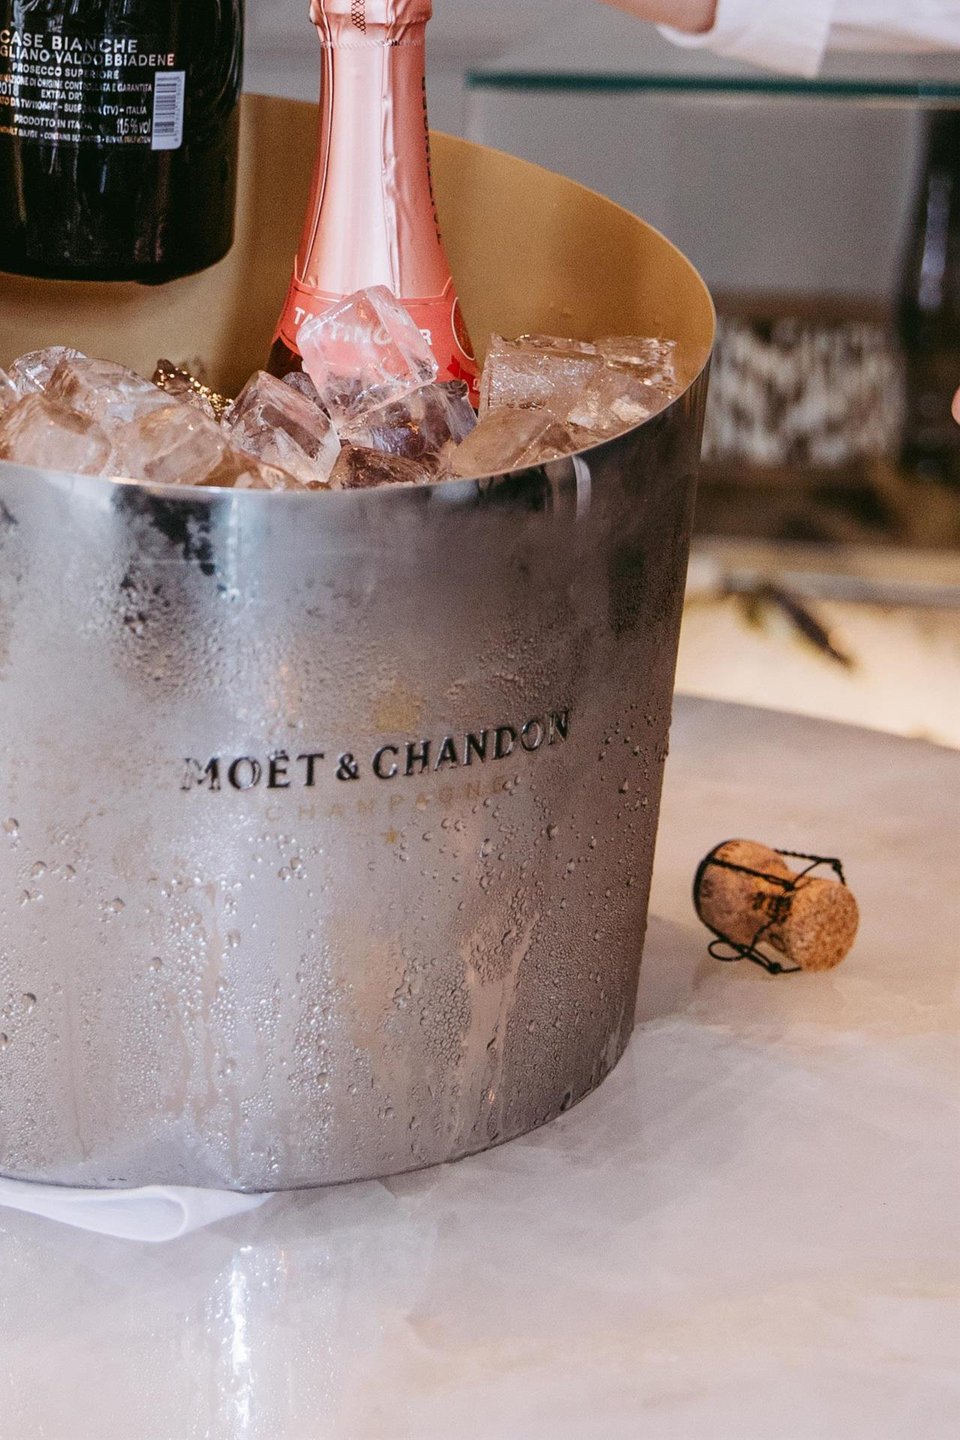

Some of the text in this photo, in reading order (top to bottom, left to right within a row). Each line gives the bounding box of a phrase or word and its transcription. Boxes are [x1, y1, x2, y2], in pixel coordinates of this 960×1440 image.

[0, 29, 138, 53] CASE BIANCHE
[55, 51, 175, 66] VALDOBBIADENE
[12, 62, 119, 80] PROSECCO SUPERIORE
[117, 83, 153, 92] GARANTITA
[41, 90, 67, 100] EXTRA
[103, 106, 119, 116] (TV)
[126, 106, 147, 115] ITALIA
[14, 115, 55, 128] PRODOTTO
[57, 119, 67, 128] IN
[181, 709, 571, 791] MOËT & CHANDON
